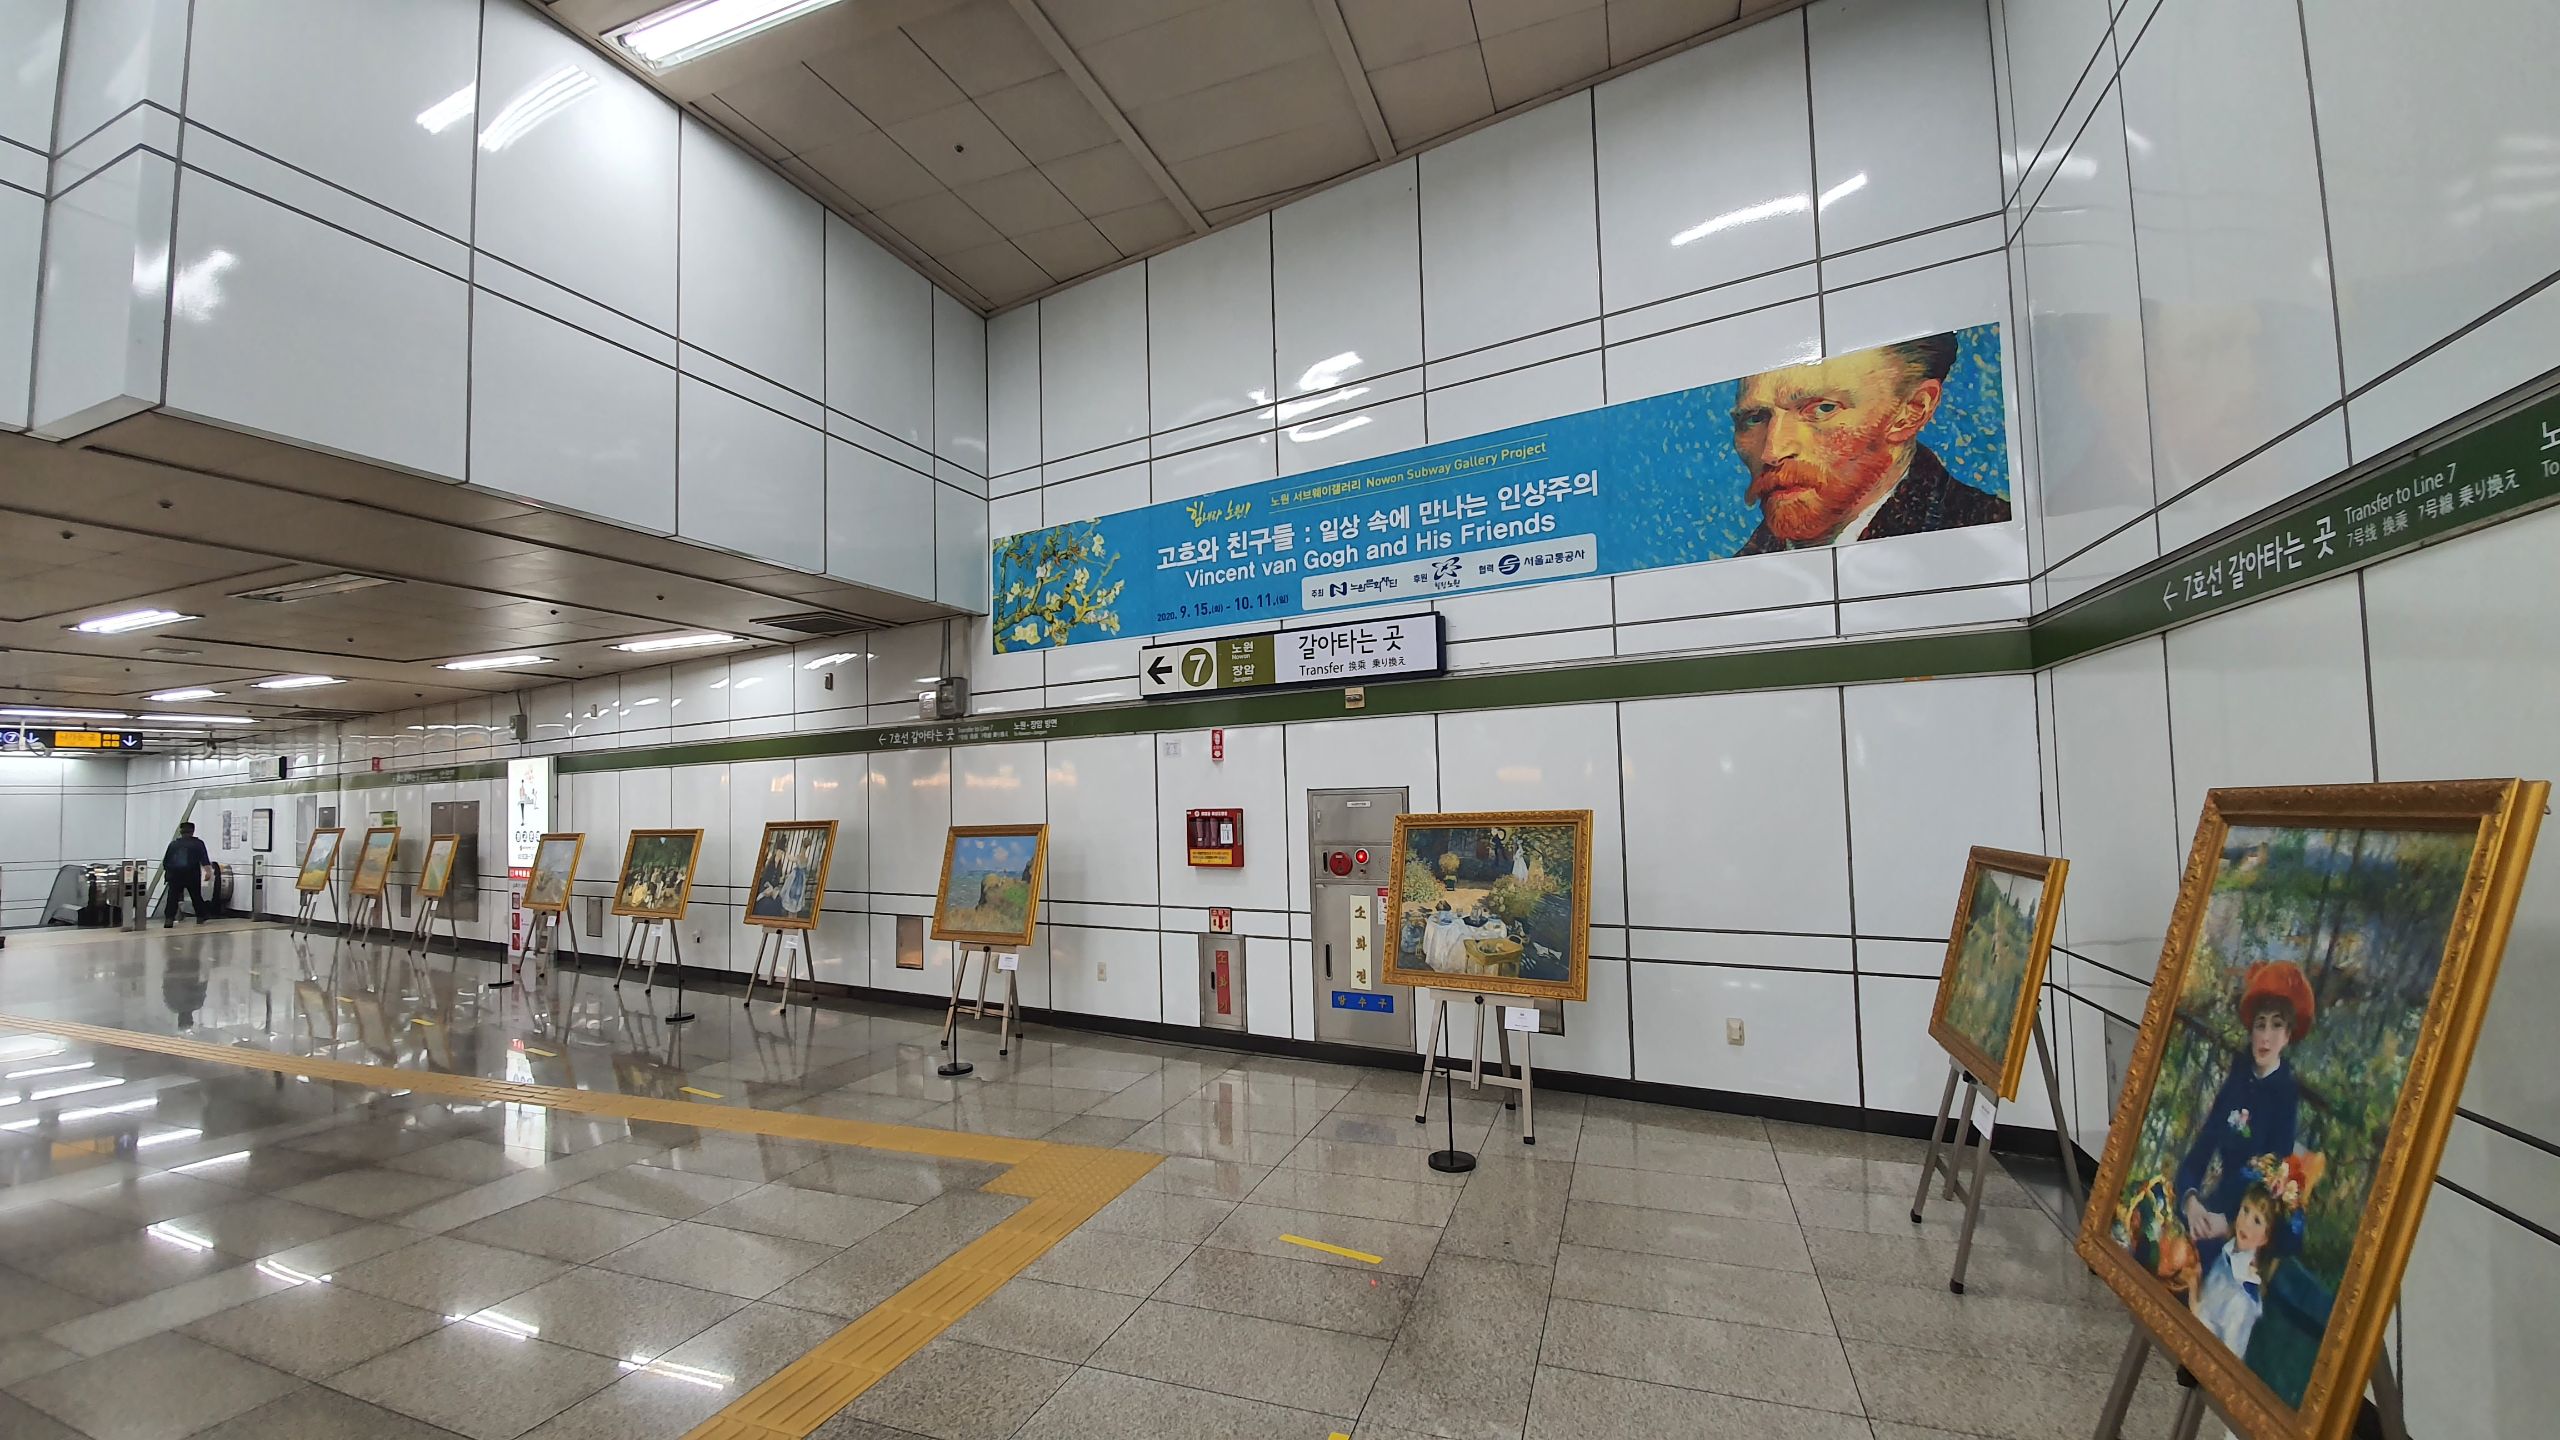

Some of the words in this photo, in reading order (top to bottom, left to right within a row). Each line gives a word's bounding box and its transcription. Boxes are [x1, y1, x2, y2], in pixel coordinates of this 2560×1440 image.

[1271, 493, 1290, 507] 노원
[1293, 478, 1361, 502] 서브웨이갤러리
[1366, 474, 1404, 488] Nowon
[1407, 462, 1452, 481] Subway
[1454, 453, 1498, 470] Gallery
[1501, 442, 1547, 461] Project
[2540, 459, 2560, 478] To
[2344, 491, 2394, 525] Transfer
[2396, 485, 2411, 504] to
[2413, 472, 2444, 498] Line
[2446, 462, 2457, 483] 7
[1156, 536, 1220, 570] 고흐와
[1227, 523, 1295, 559] 친구들
[1304, 526, 1311, 543] :
[1319, 514, 1361, 543] 일상
[1367, 505, 1411, 533] 속에
[1419, 493, 1488, 525] 만나는
[1497, 469, 1599, 511] 인상주의
[1186, 500, 1222, 528] 힘내라
[1184, 562, 1255, 588] Vincent
[1261, 557, 1297, 577] van
[1303, 543, 1359, 570] Gogh
[1366, 535, 1408, 560] and
[1416, 529, 1452, 552] His
[1461, 511, 1556, 545] Friends
[1523, 550, 1586, 567] 서울교통공사
[2183, 560, 2223, 602] 7호선
[2228, 531, 2305, 590] 갈아타는
[2312, 515, 2337, 560] 곳
[1413, 573, 1428, 583] 후원
[1478, 563, 1494, 574] 협력
[1311, 588, 1324, 598] 주최
[1157, 612, 1178, 622] 2020.
[1231, 641, 1254, 654] 노원
[1299, 629, 1378, 660] 갈아타는
[1383, 625, 1404, 651] 곳
[1189, 653, 1207, 683] 7
[1232, 663, 1255, 676] 장암
[1299, 662, 1344, 676] Transfer
[888, 732, 909, 745] 7호선
[911, 728, 943, 744] 갈아타는
[946, 727, 955, 741] 곳
[1353, 905, 1368, 985] 소화전
